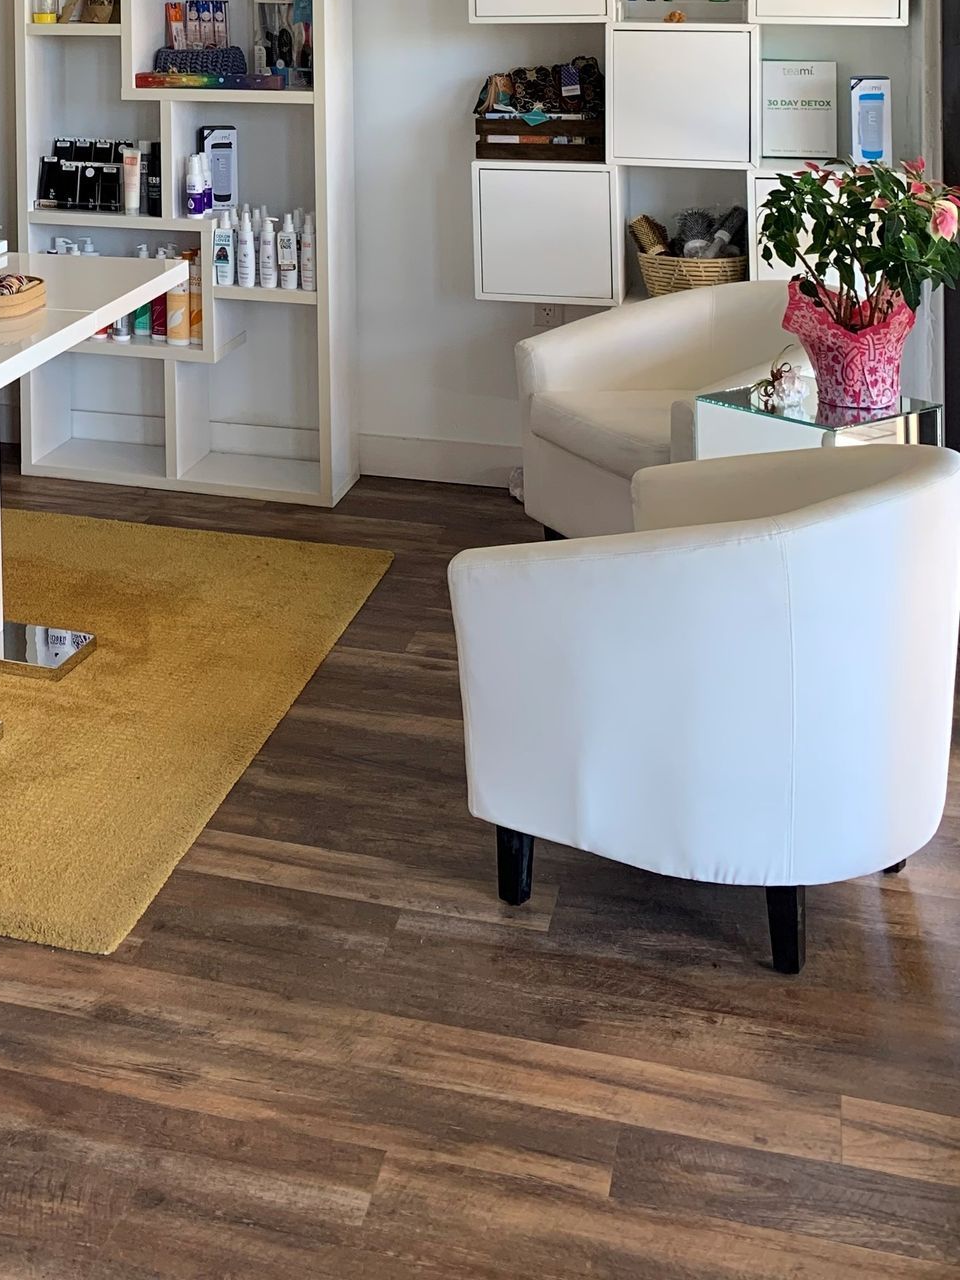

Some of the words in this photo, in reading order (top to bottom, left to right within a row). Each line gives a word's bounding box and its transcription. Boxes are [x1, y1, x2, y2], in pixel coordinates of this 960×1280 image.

[767, 99, 779, 107] 30
[780, 99, 799, 107] DAY
[800, 99, 832, 107] DETOX
